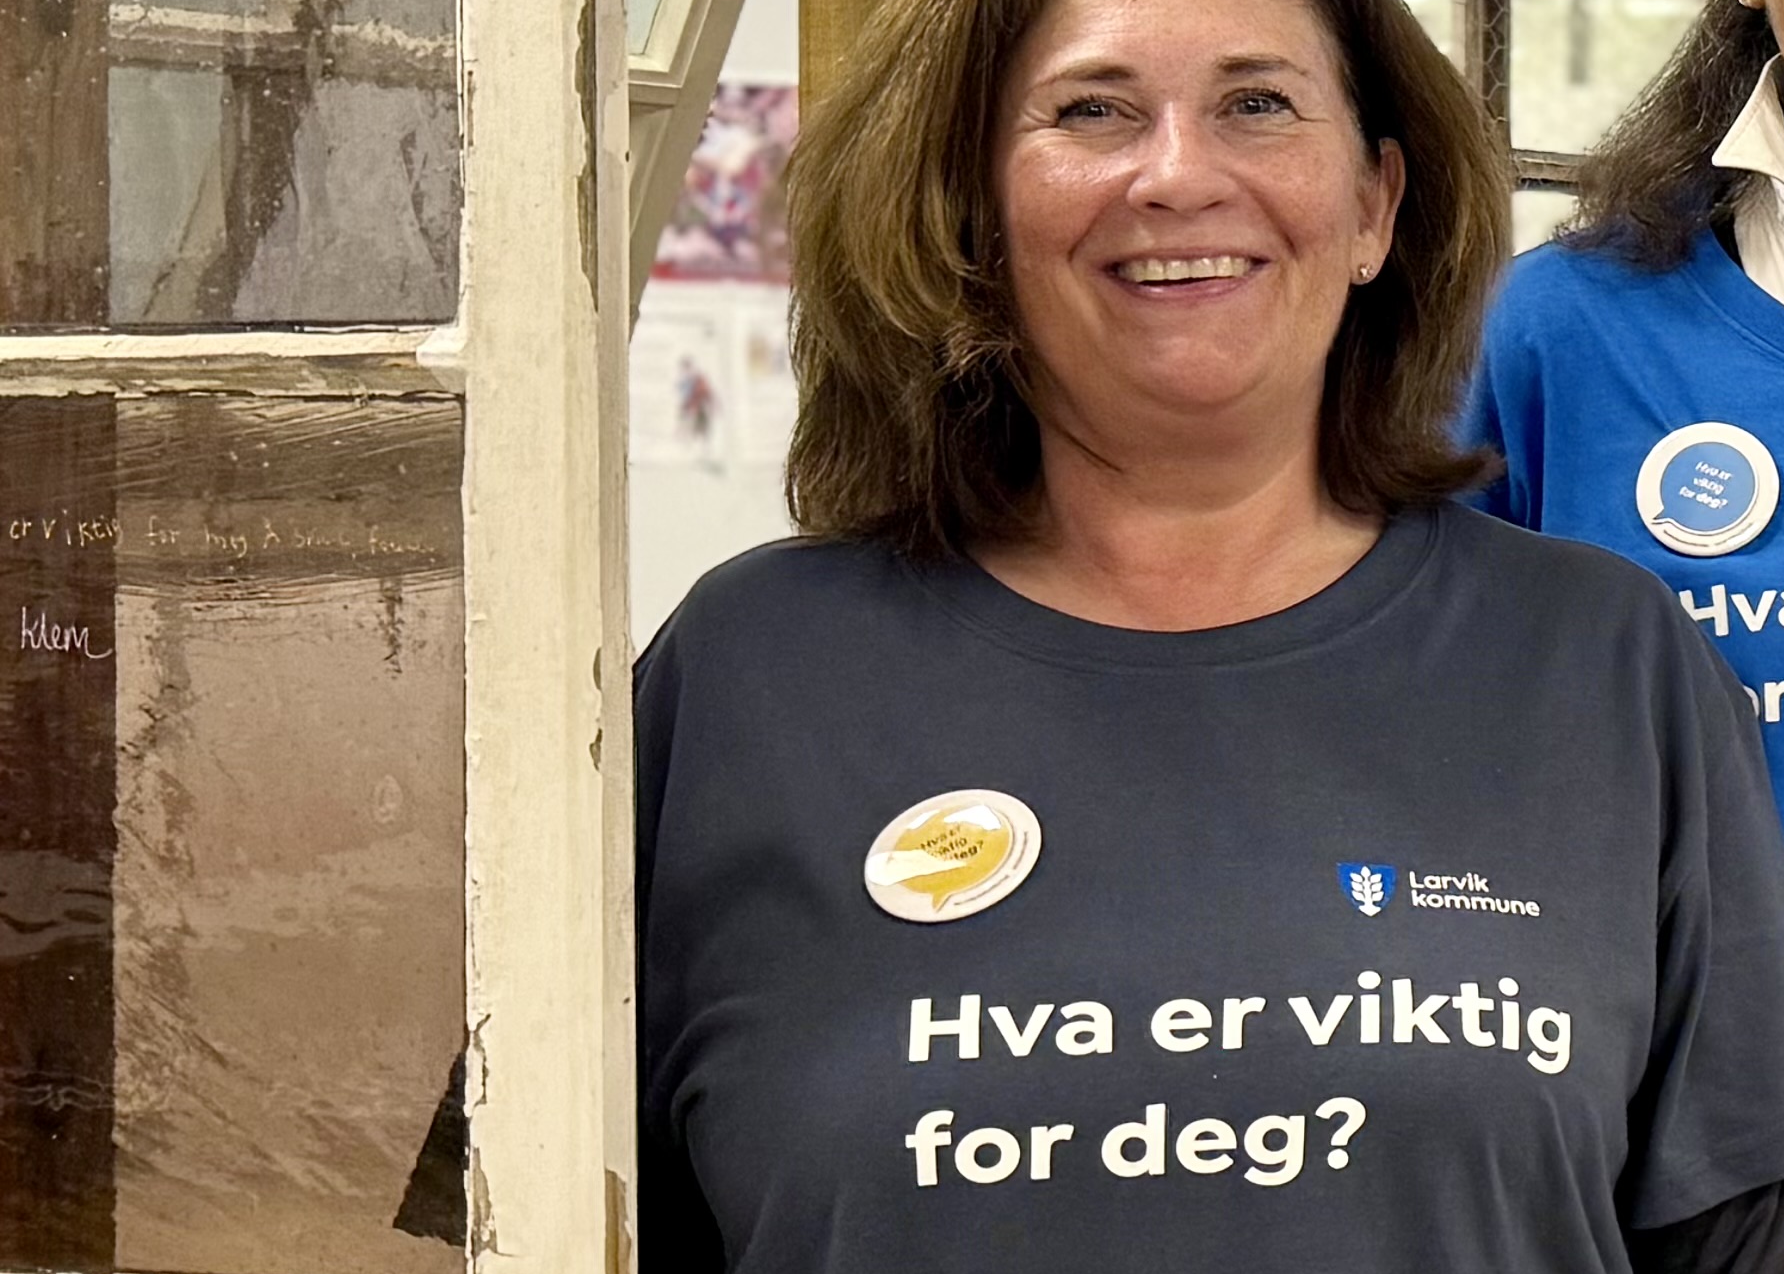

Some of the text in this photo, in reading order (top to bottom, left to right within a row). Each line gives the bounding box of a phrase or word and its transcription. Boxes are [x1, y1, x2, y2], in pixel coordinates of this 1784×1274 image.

[1409, 870, 1489, 893] Larvik
[1411, 889, 1541, 917] kommune
[907, 970, 1573, 1075] Hva er viktig
[905, 1096, 1368, 1187] for deg?
